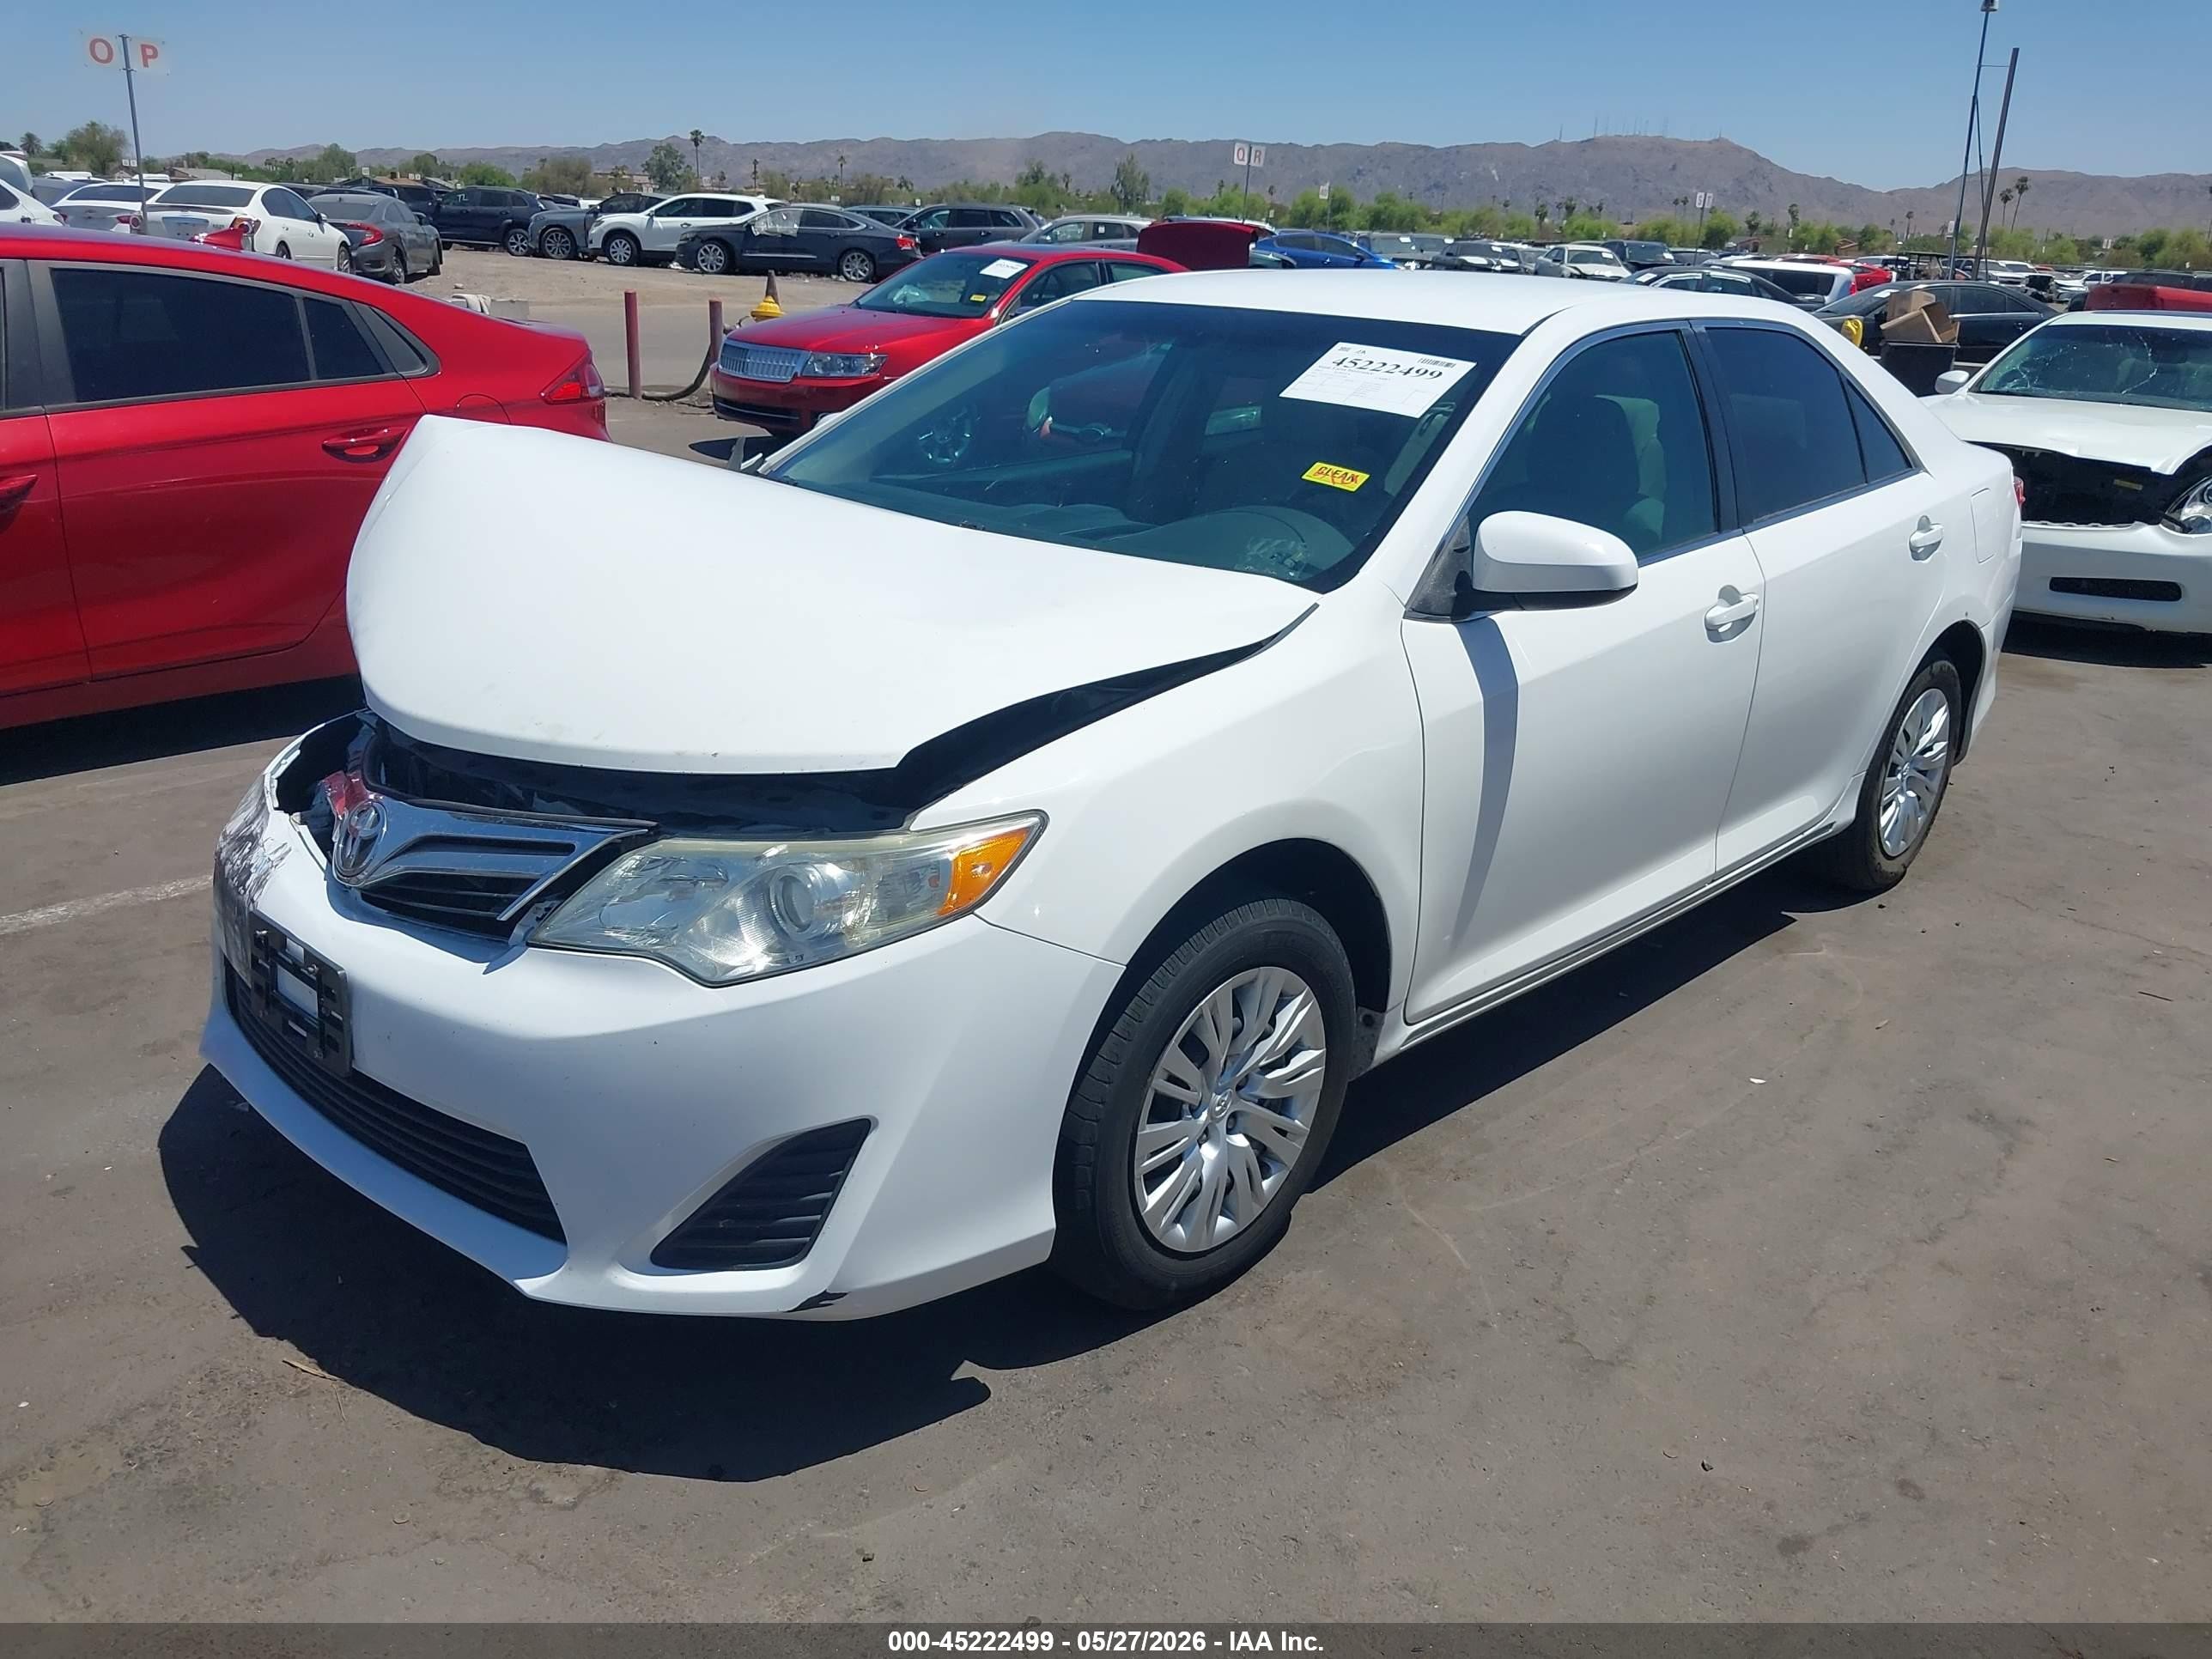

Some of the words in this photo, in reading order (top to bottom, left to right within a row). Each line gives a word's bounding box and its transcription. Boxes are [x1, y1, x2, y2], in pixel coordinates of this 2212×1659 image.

[140, 44, 158, 68] P
[1237, 147, 1245, 162] Q
[1254, 149, 1262, 165] R
[1333, 356, 1443, 380] 45222499
